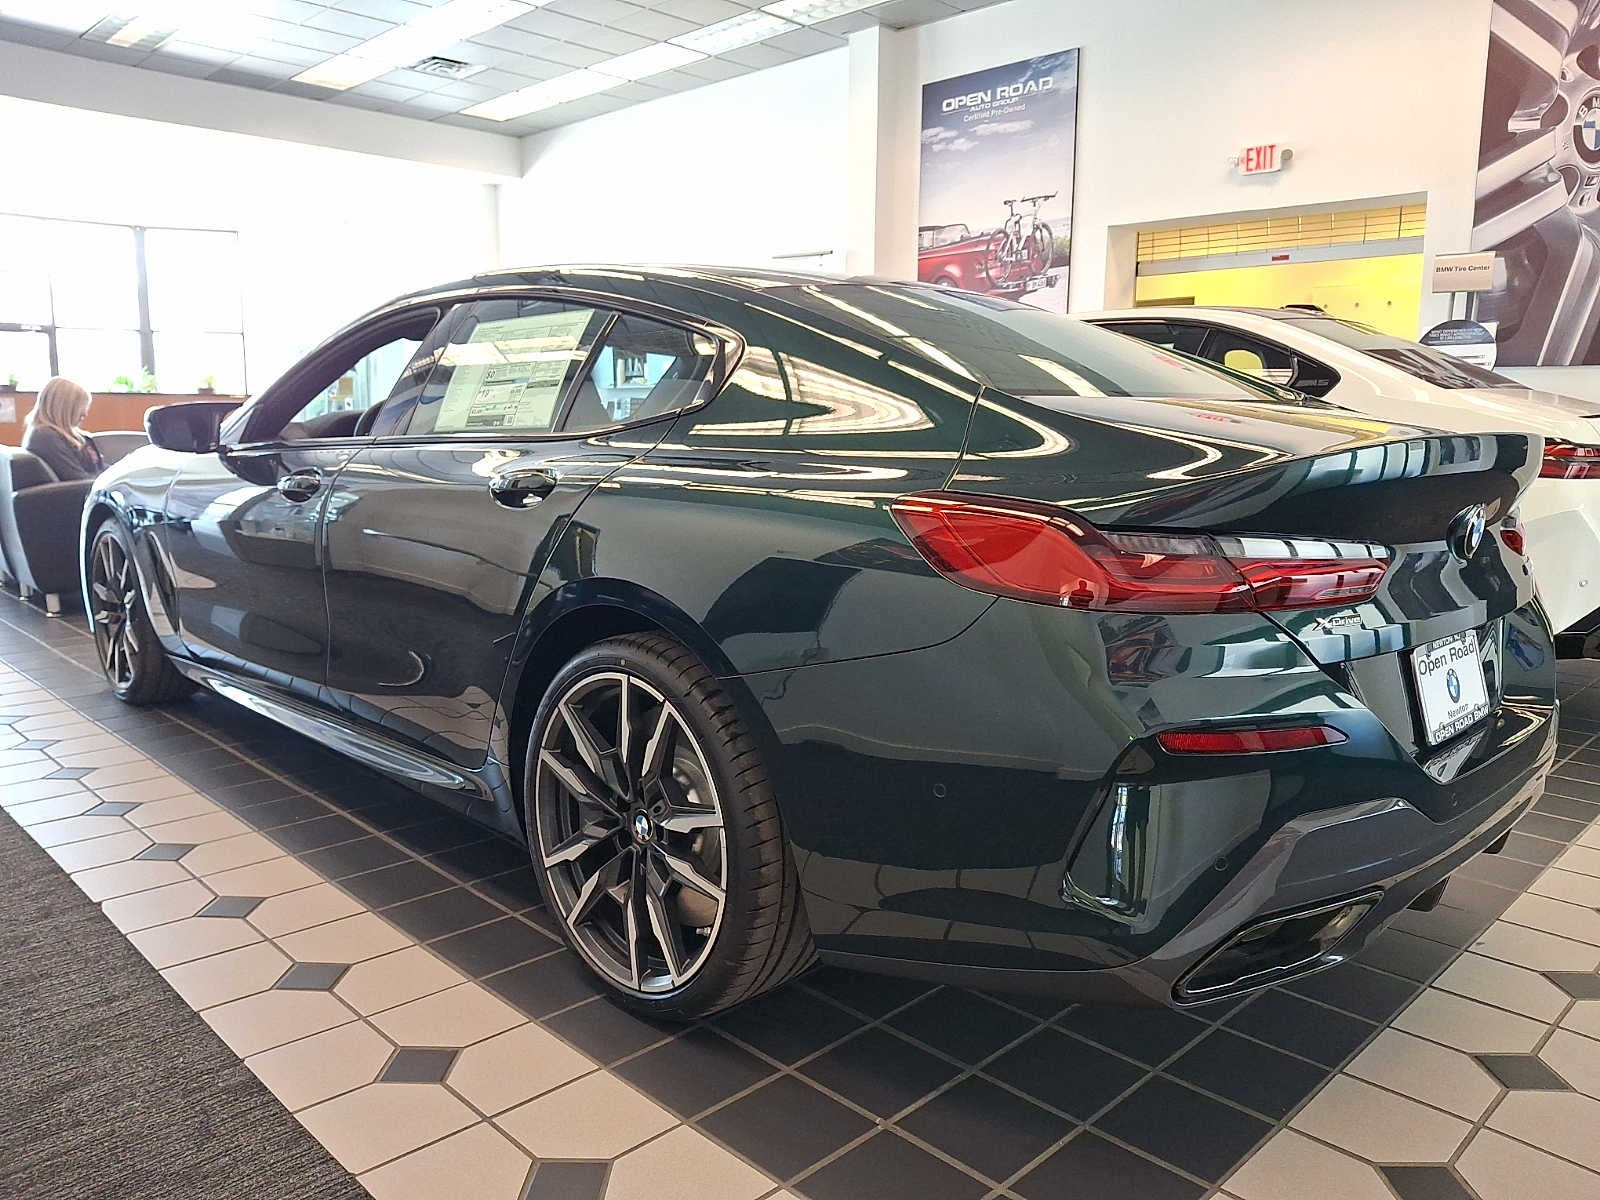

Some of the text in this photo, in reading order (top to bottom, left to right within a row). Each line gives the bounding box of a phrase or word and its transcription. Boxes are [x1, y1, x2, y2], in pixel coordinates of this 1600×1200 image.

[942, 77, 1054, 112] OPEN ROAD
[969, 98, 1019, 112] AUTO GROUP
[1246, 145, 1276, 171] EXIT
[1418, 642, 1475, 677] Open Road
[1447, 703, 1469, 719] Newton
[1434, 724, 1455, 742] OPEN
[1454, 713, 1474, 732] ROAD
